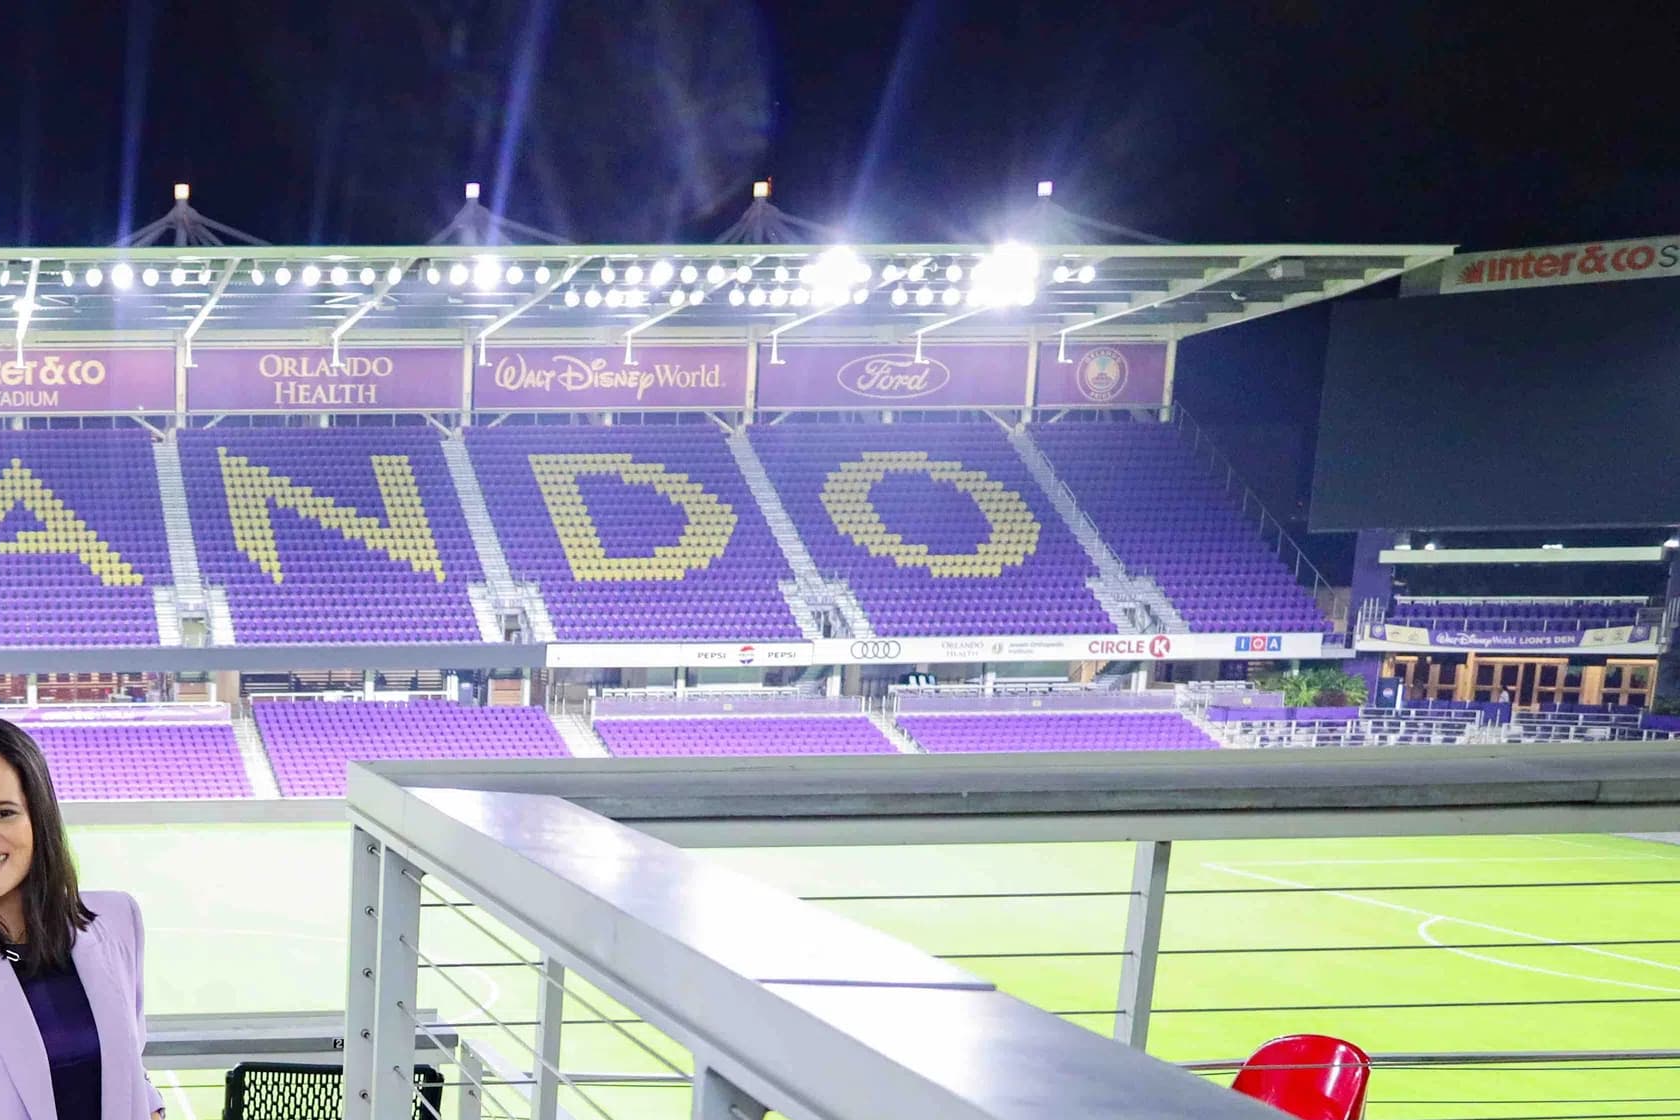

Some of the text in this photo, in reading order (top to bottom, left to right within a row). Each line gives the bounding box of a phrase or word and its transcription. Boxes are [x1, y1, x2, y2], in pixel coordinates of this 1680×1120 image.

[259, 354, 393, 377] ORLANDO
[858, 358, 929, 392] Ford
[273, 381, 379, 405] HEALTH
[697, 651, 727, 660] PEPSI
[767, 651, 797, 660] PEPSI
[1088, 640, 1145, 654] CIRCLE
